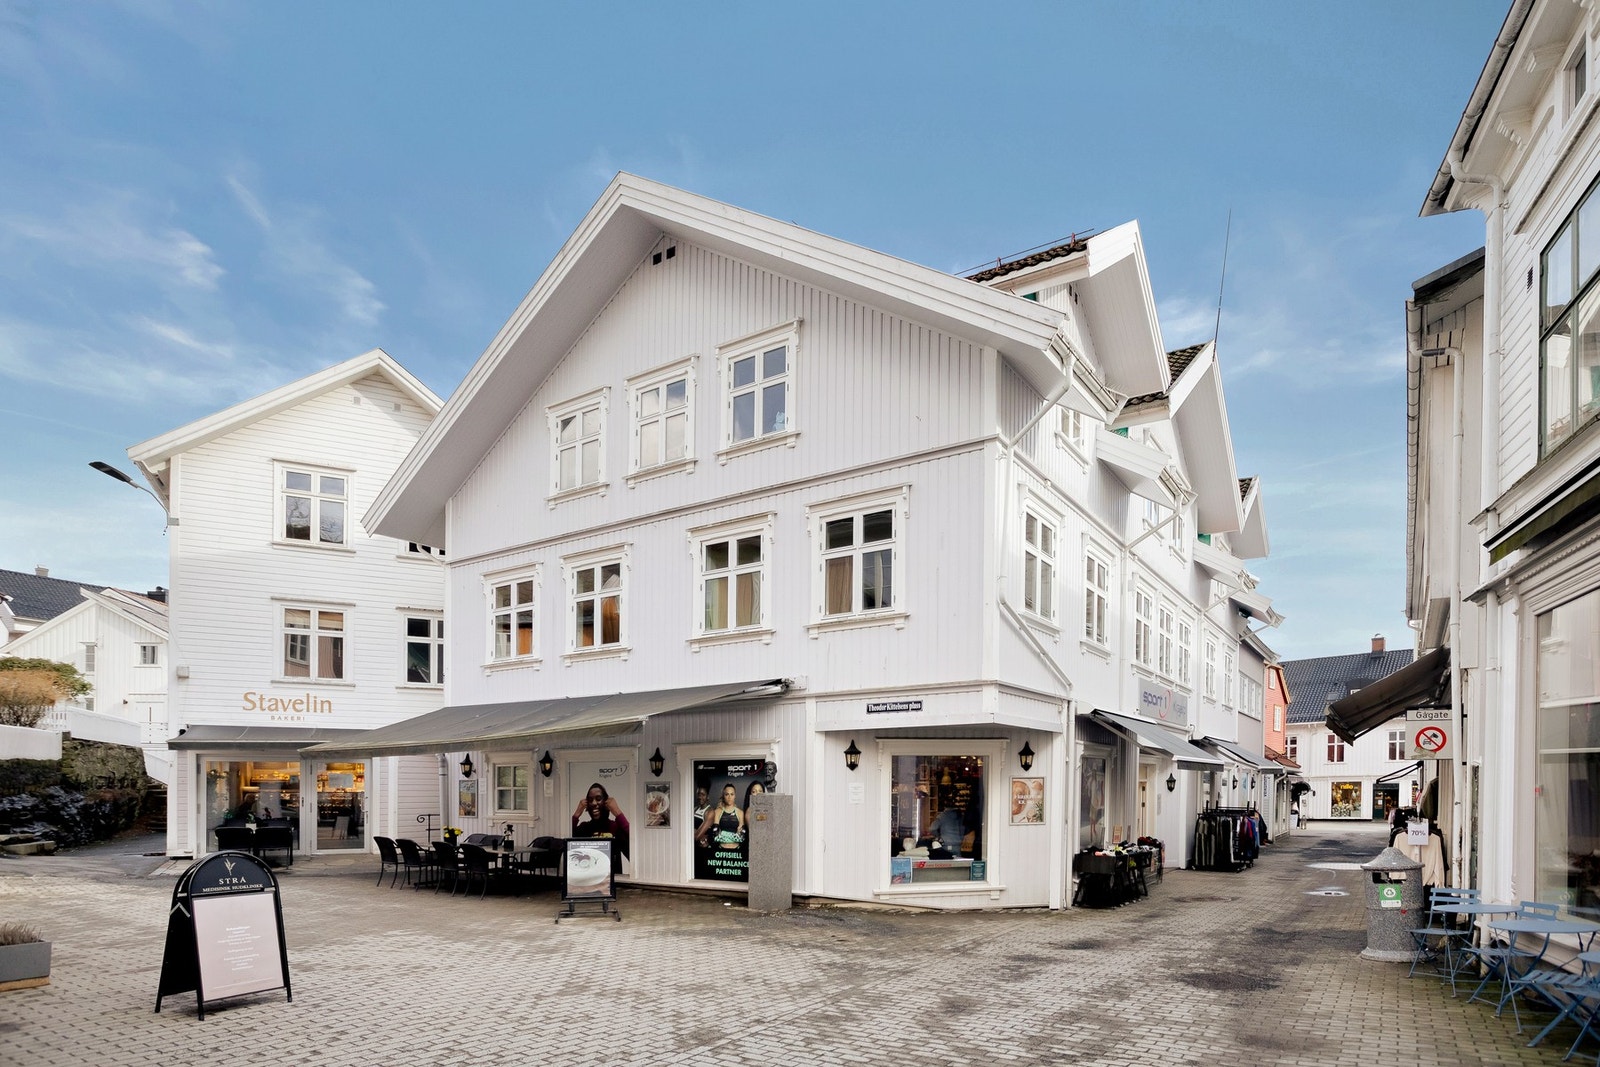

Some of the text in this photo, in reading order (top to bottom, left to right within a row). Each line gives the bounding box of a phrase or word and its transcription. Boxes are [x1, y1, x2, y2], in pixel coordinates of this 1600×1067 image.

[242, 691, 332, 713] Stavelin
[868, 703, 887, 712] Theodor
[886, 702, 909, 711] Kittelsens
[1415, 711, 1449, 721] Gågate
[727, 764, 752, 772] sport
[714, 851, 743, 859] OFFISIELL
[715, 867, 742, 876] PARTNER
